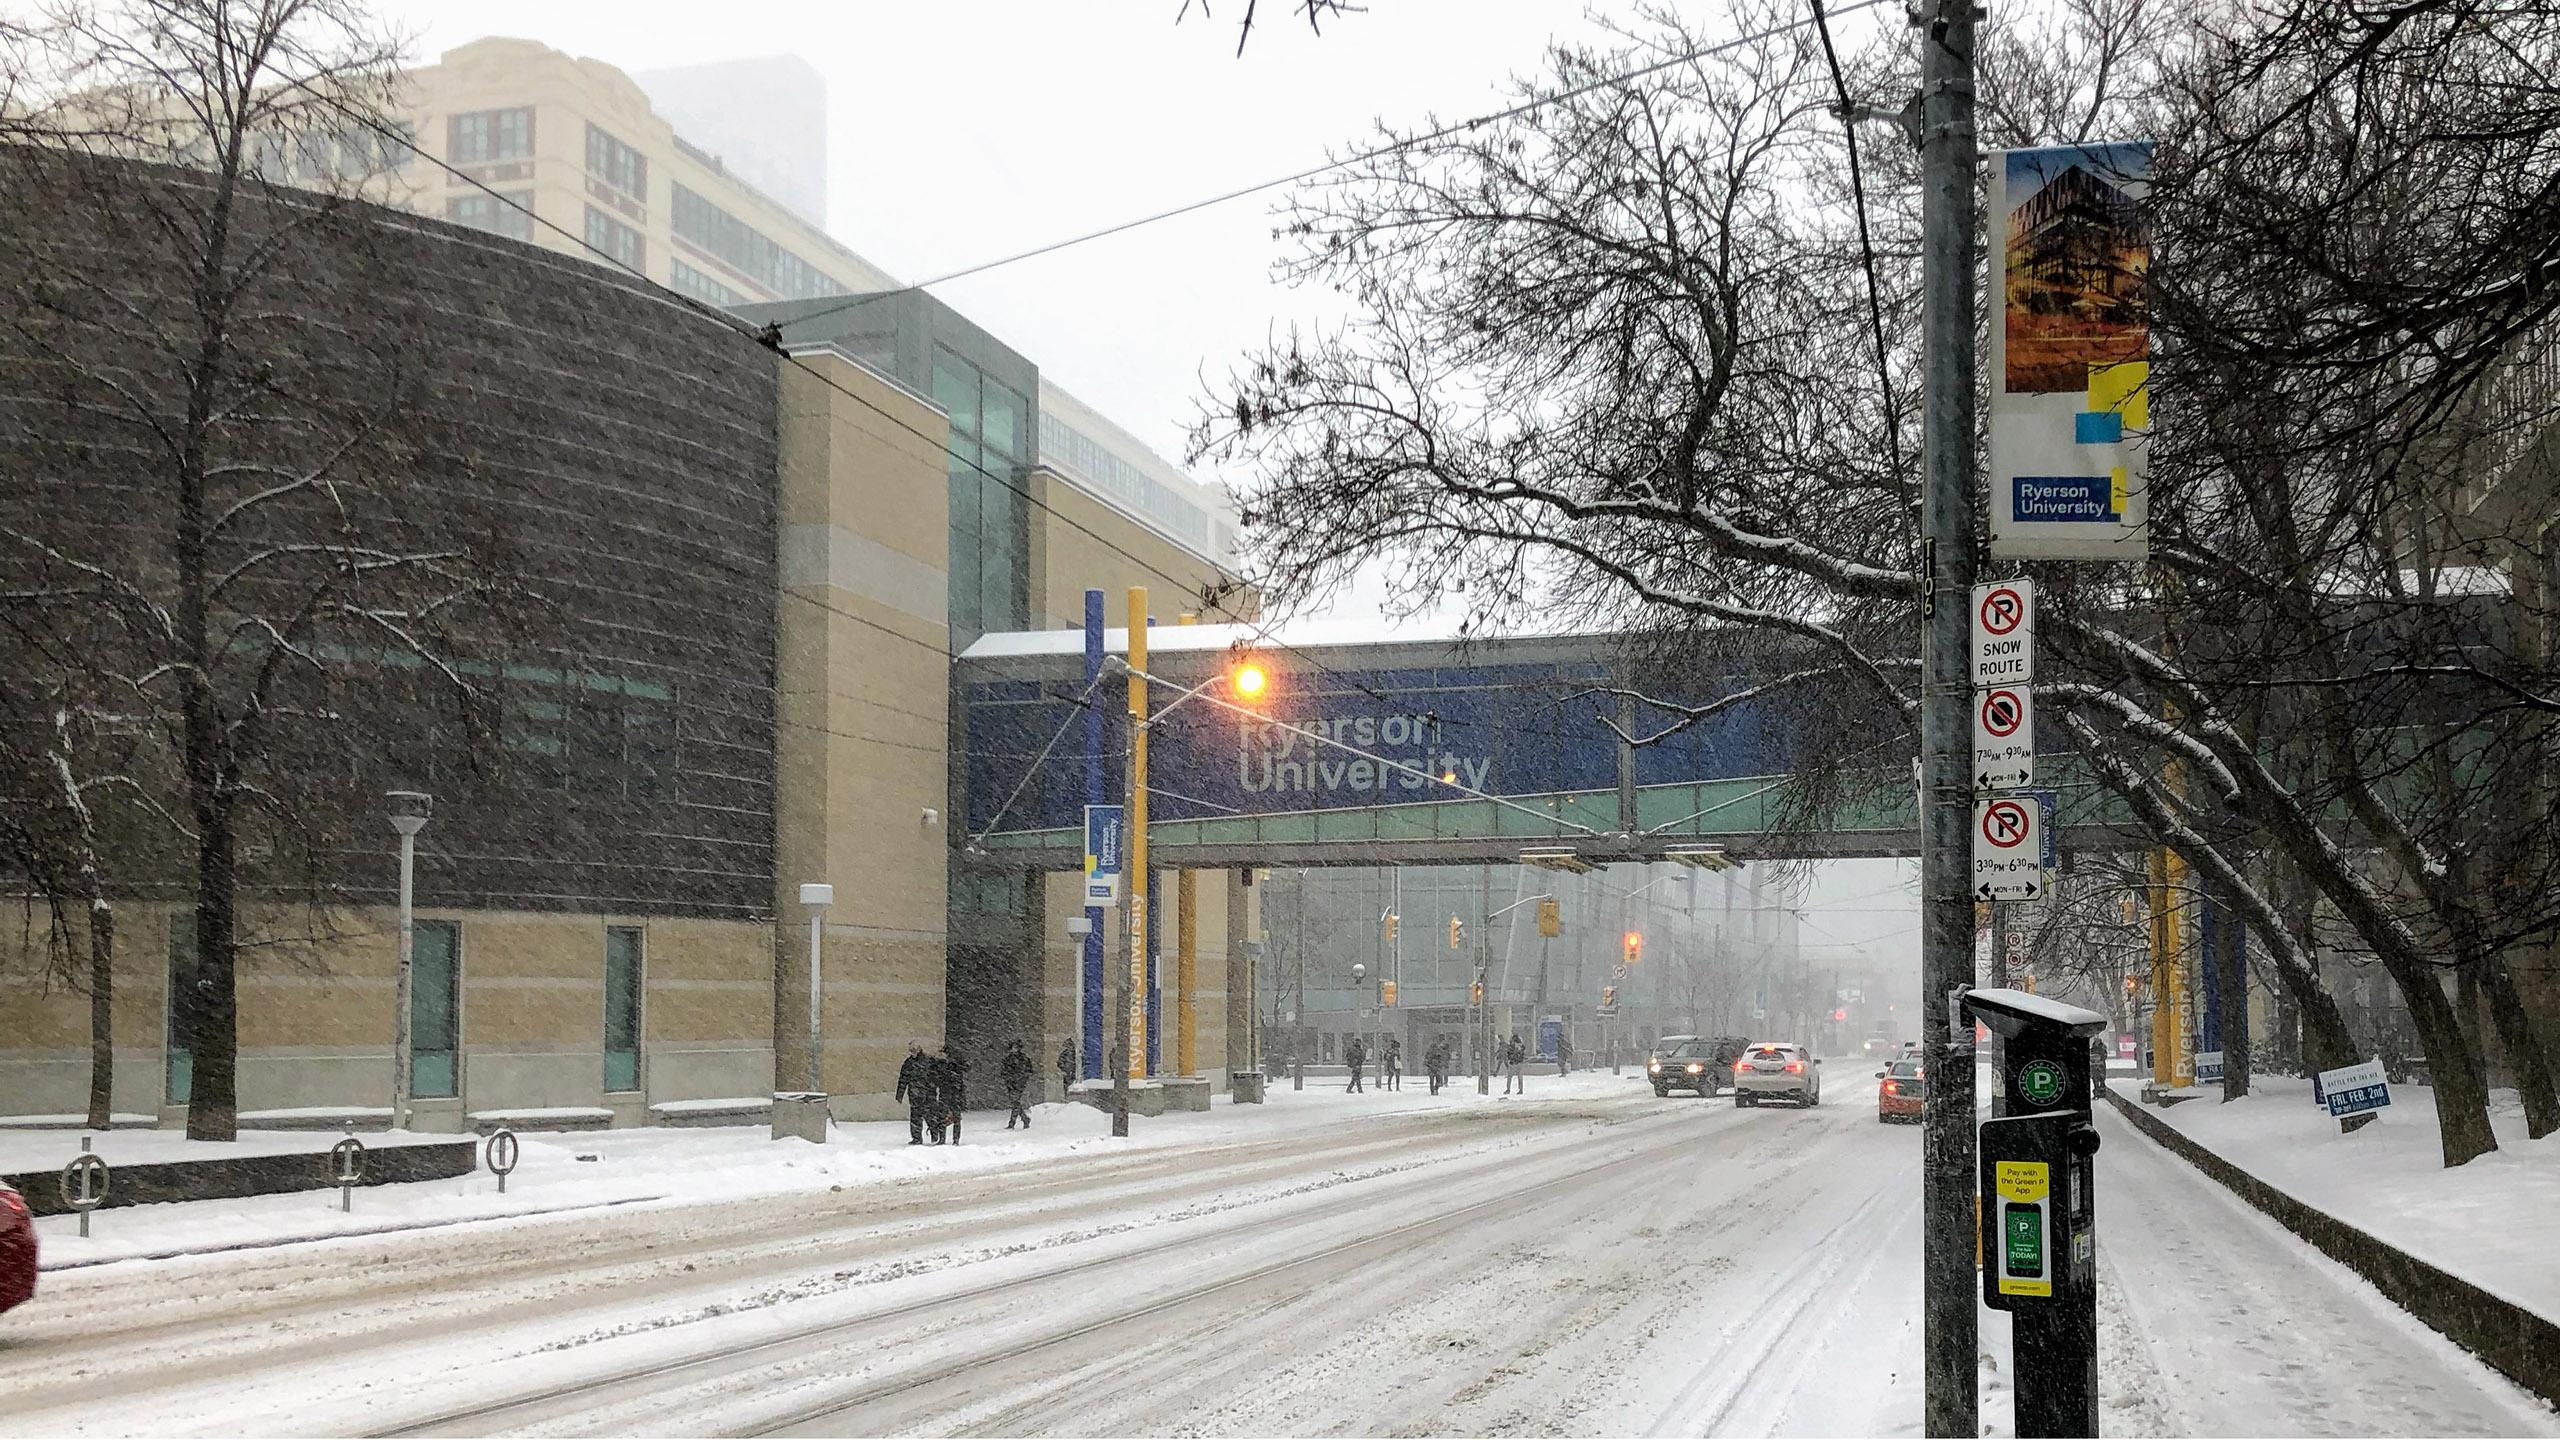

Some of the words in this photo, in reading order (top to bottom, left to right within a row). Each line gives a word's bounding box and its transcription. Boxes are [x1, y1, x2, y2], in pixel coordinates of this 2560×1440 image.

[2021, 483, 2089, 501] Ryerson
[2021, 499, 2105, 517] University
[1983, 640, 2021, 656] SNOW
[1980, 659, 2024, 676] ROUTE
[1239, 712, 1442, 757] Ryerson
[1239, 748, 1491, 793] University
[2175, 990, 2194, 1078] Ryerson
[2348, 1089, 2368, 1103] FEB.
[2367, 1085, 2384, 1099] 2nd
[2007, 1169, 2020, 1177] Pay
